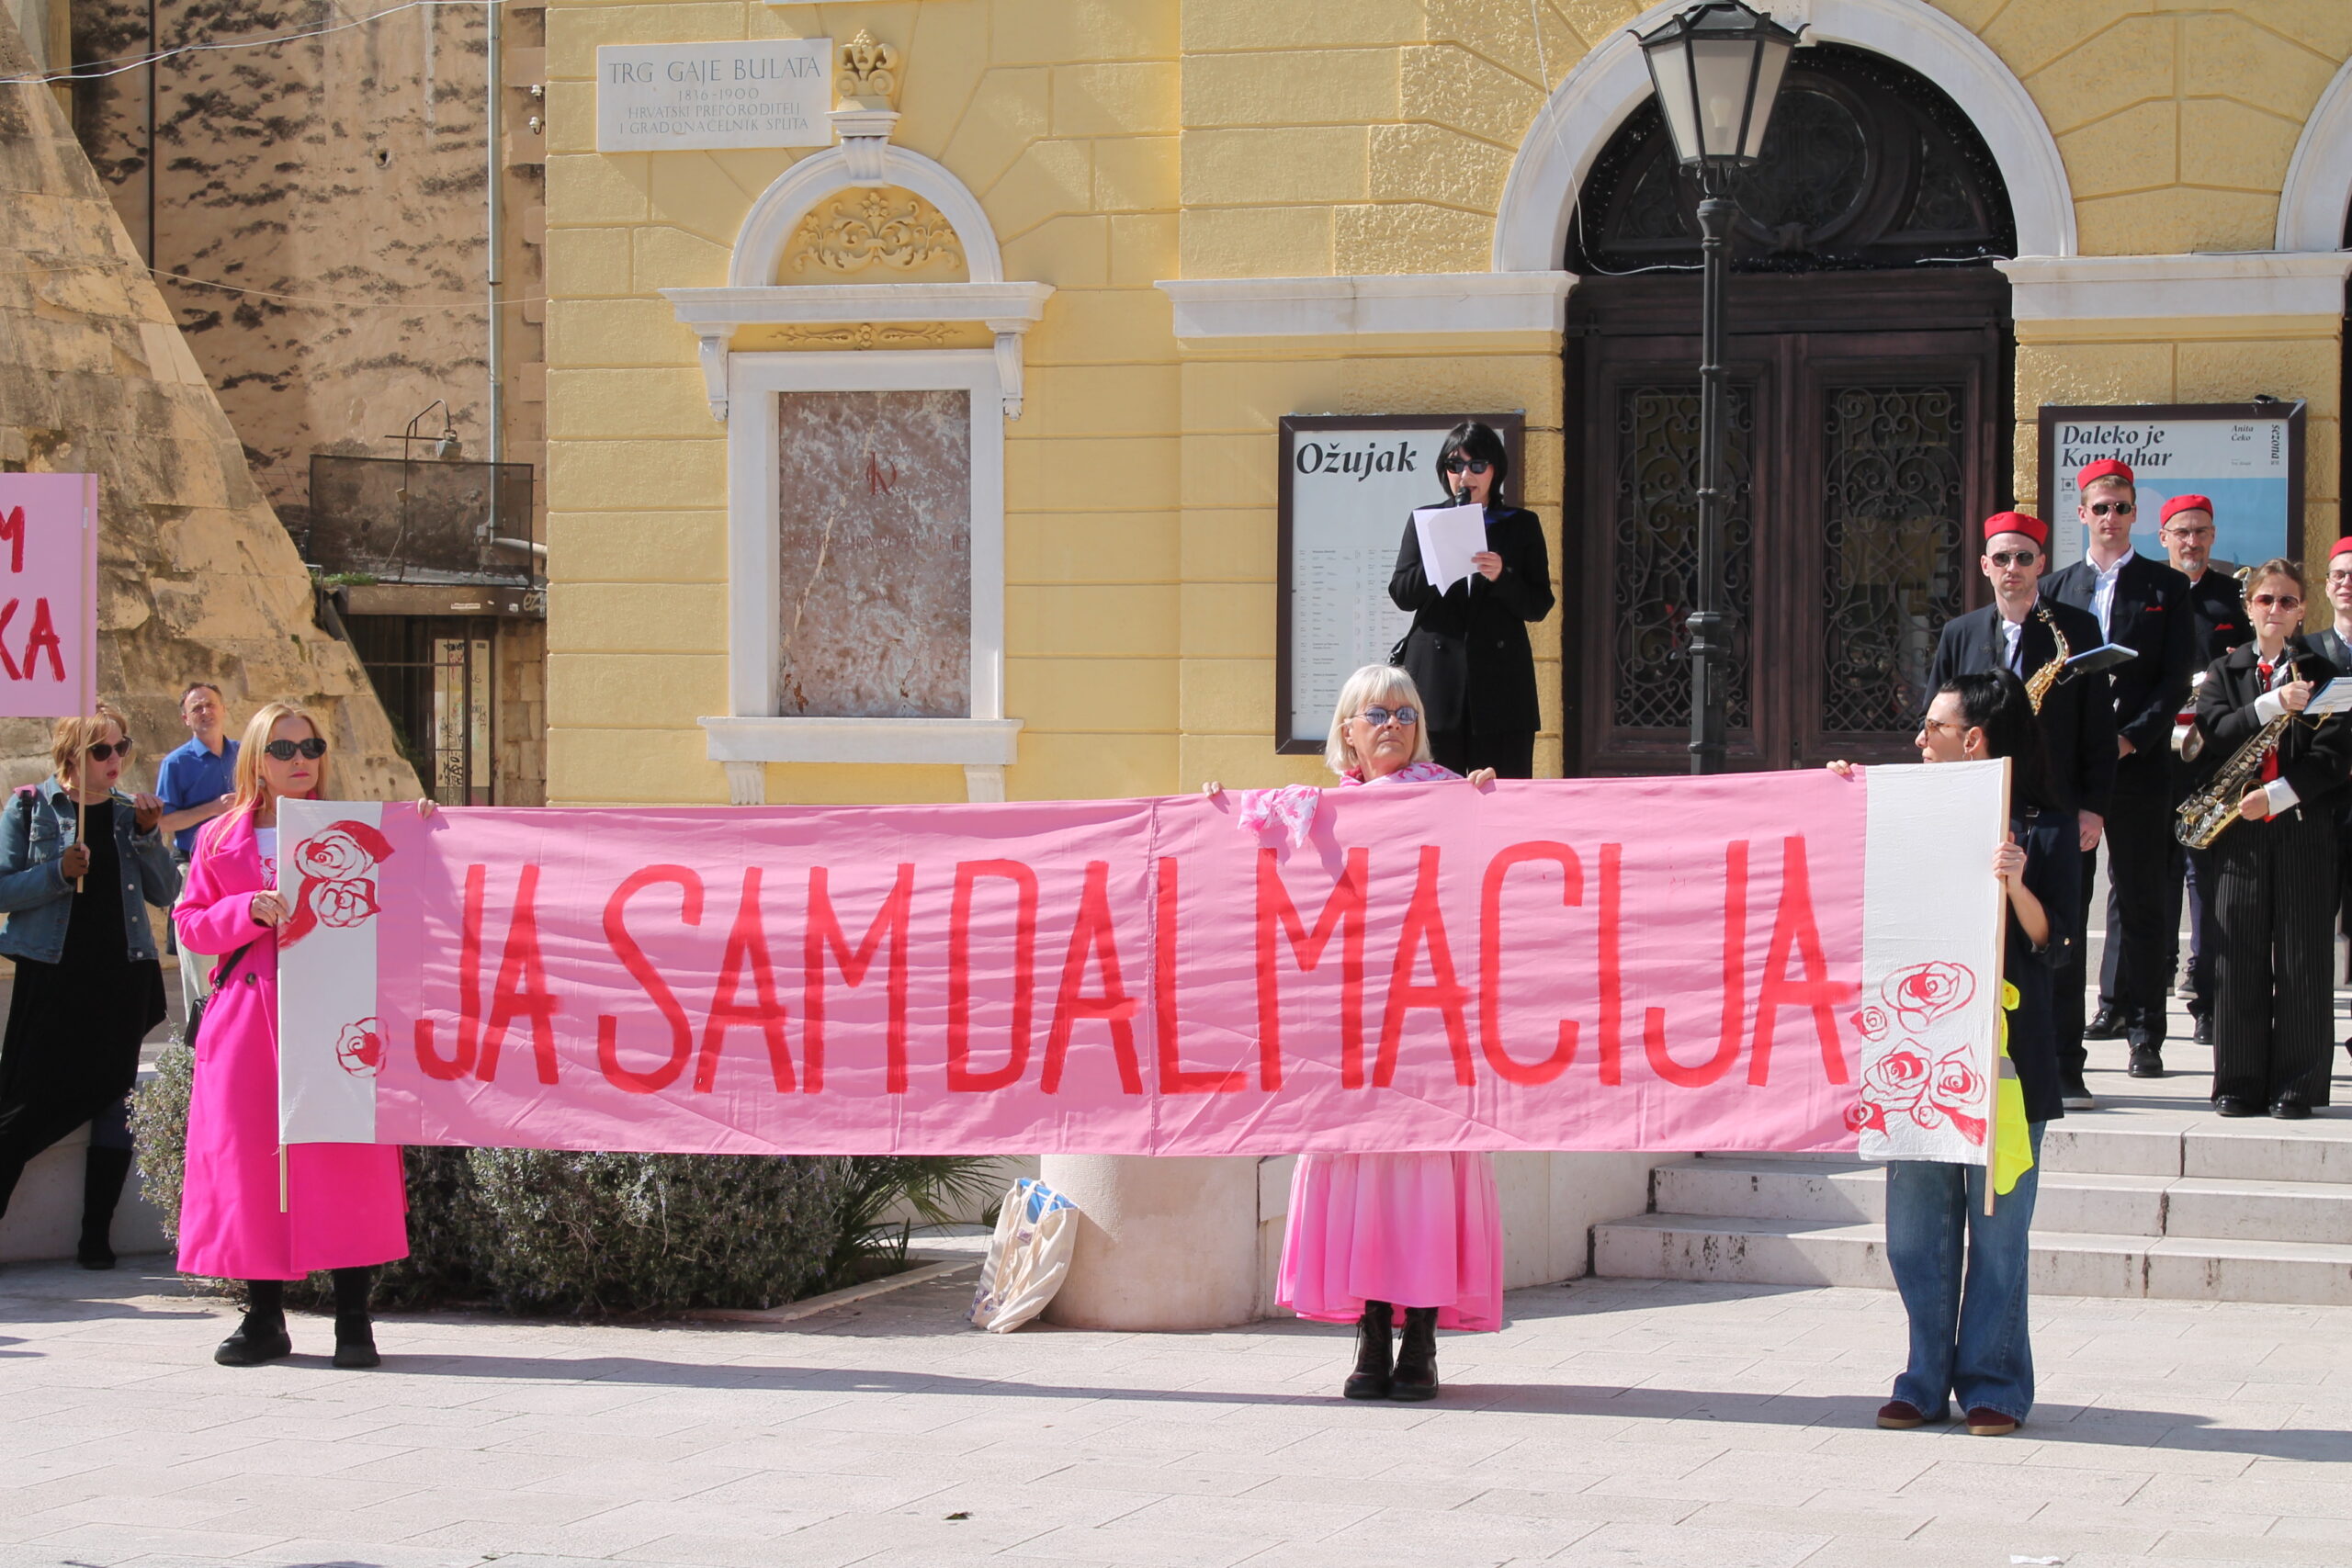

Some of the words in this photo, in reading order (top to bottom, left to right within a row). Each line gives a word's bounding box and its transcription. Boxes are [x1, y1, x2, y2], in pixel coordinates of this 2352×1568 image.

[608, 62, 654, 85] TRG
[667, 60, 722, 86] GAJE
[734, 56, 821, 81] BULATA
[628, 106, 691, 119] HRVATSKI
[766, 117, 809, 131] SPLITA
[2062, 424, 2139, 445] Daleko
[2142, 424, 2165, 450] je
[2232, 424, 2255, 433] Anita
[2270, 423, 2280, 459] sezona
[1296, 441, 1418, 482] Ožujak
[413, 863, 562, 1086] JA
[597, 863, 915, 1096] SAM
[946, 836, 1862, 1096] DALMACIJA
